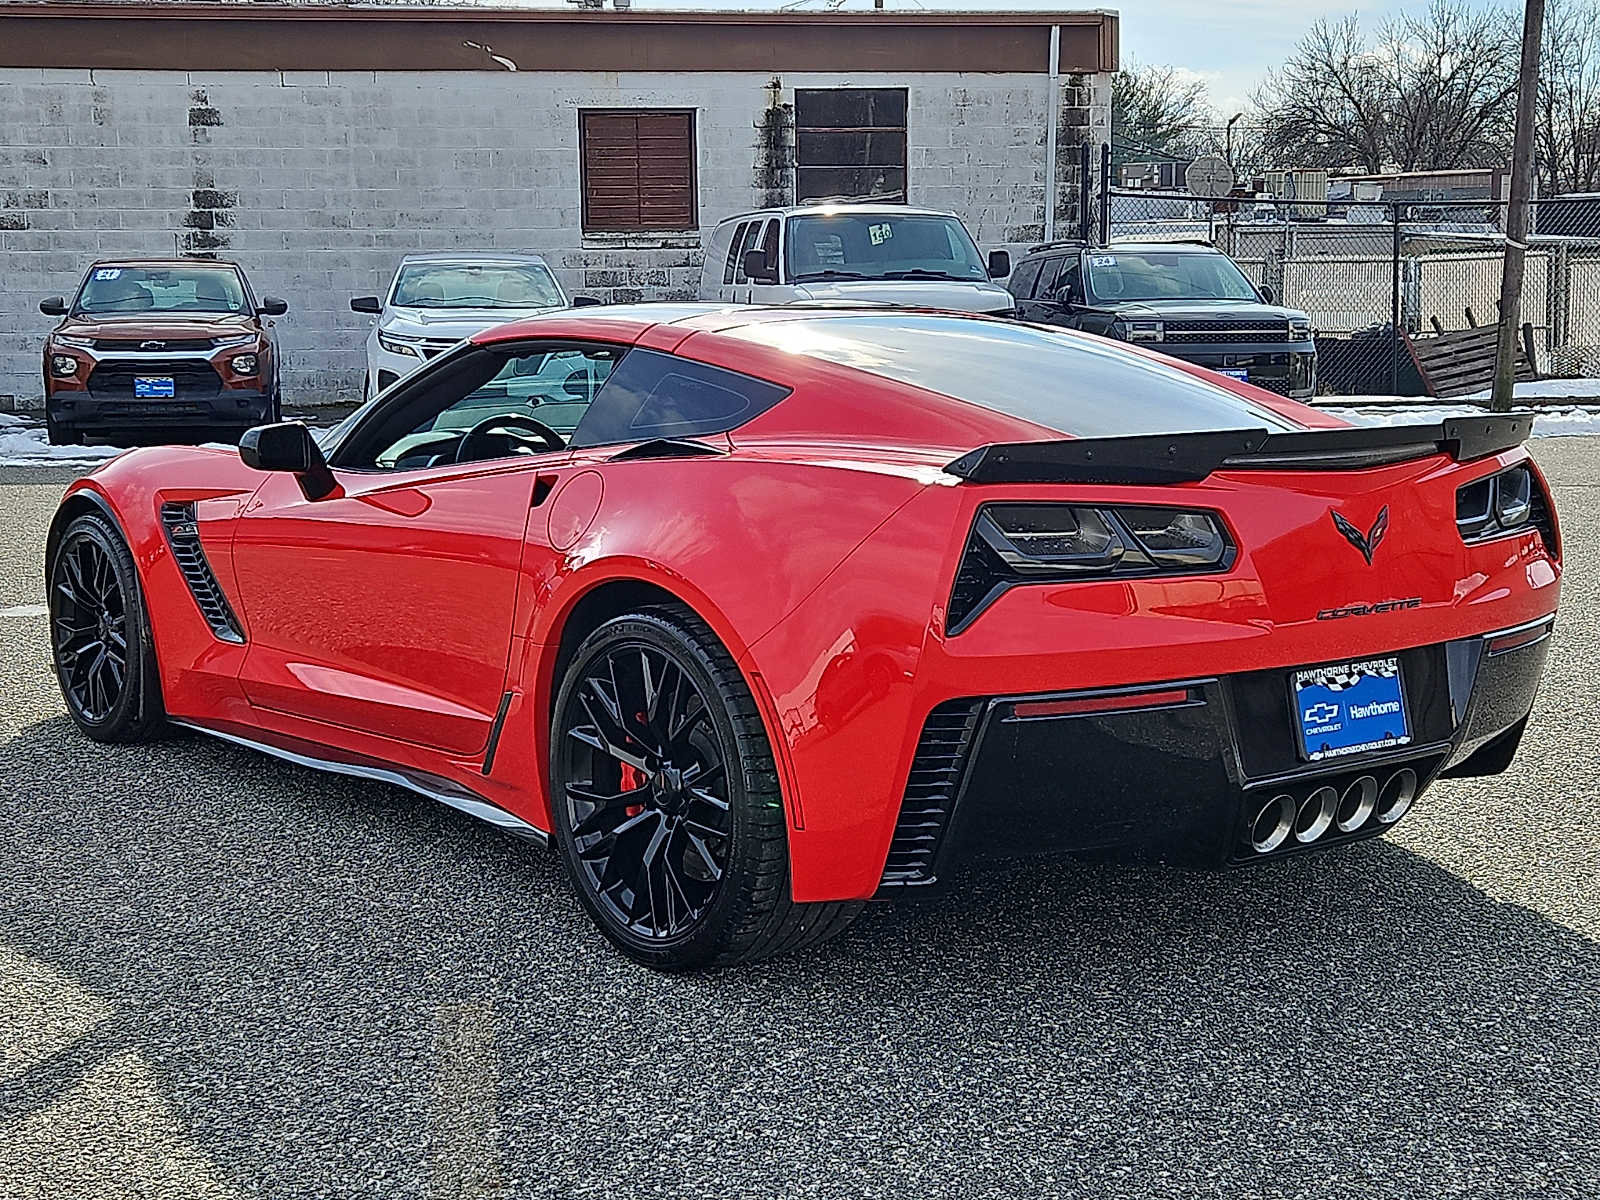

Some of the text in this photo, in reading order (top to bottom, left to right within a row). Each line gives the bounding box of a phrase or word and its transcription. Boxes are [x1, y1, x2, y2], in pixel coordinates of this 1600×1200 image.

[1317, 597, 1422, 620] CORVETTE
[1296, 657, 1398, 682] HAWTHORNE CHEVROLET
[1350, 701, 1400, 719] Hawthorne
[1305, 723, 1342, 736] CHEVROLET
